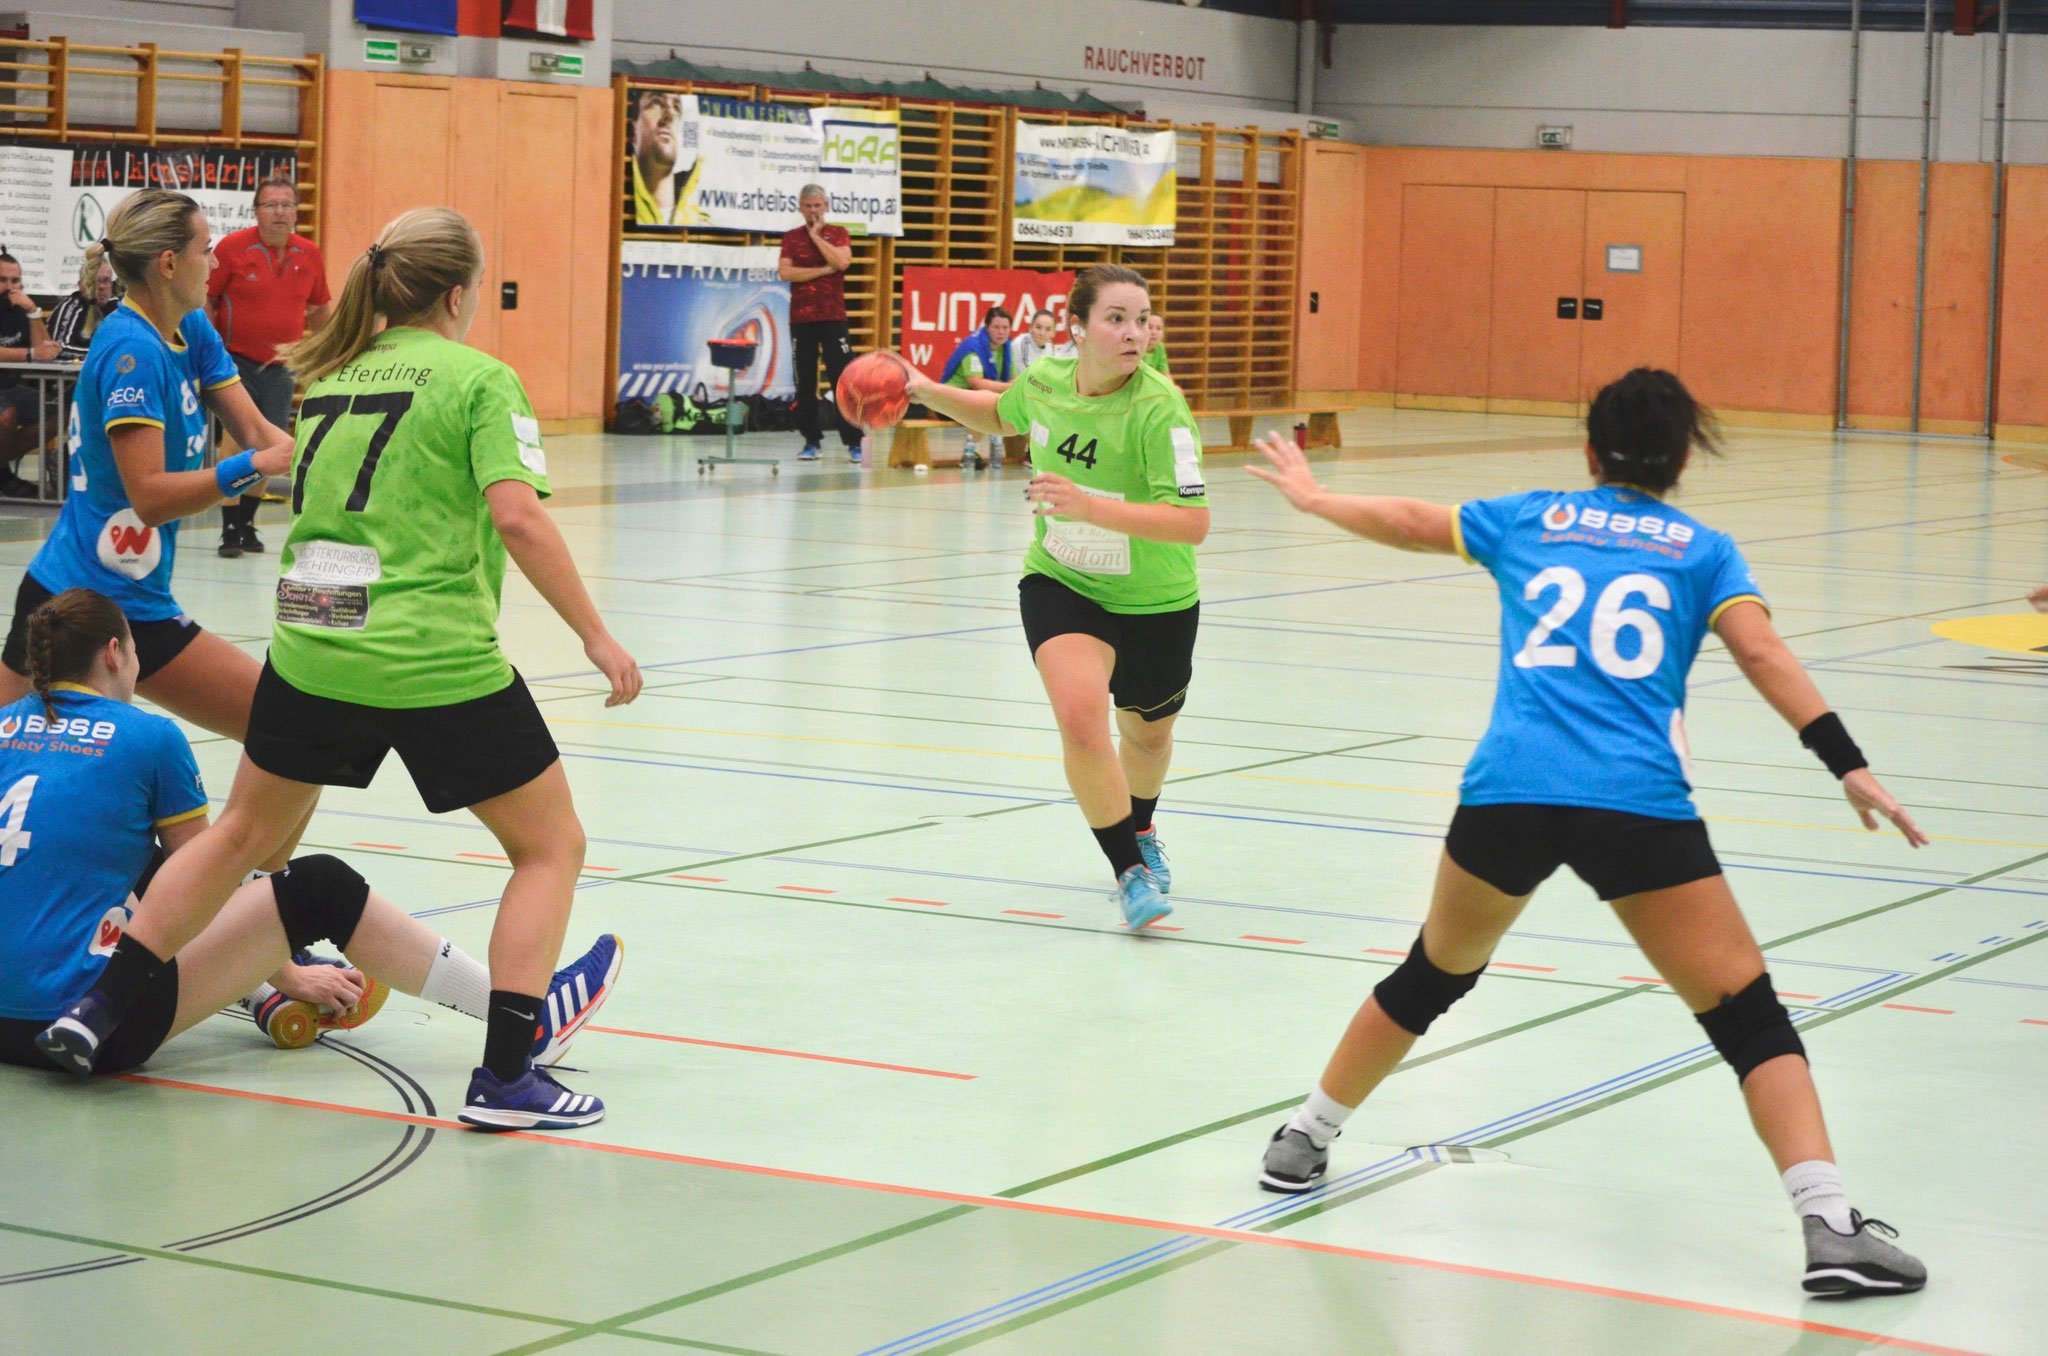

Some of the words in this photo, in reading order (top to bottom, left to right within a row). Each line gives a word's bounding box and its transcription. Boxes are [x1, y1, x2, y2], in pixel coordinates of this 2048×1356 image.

[1085, 46, 1206, 80] RAUCHVERBOT
[337, 363, 433, 386] Eferding
[107, 387, 145, 407] PEGA
[293, 392, 414, 515] 77
[1056, 433, 1098, 470] 44
[1514, 566, 1671, 680] 26
[0, 739, 45, 753] afety
[50, 741, 105, 757] Shoes
